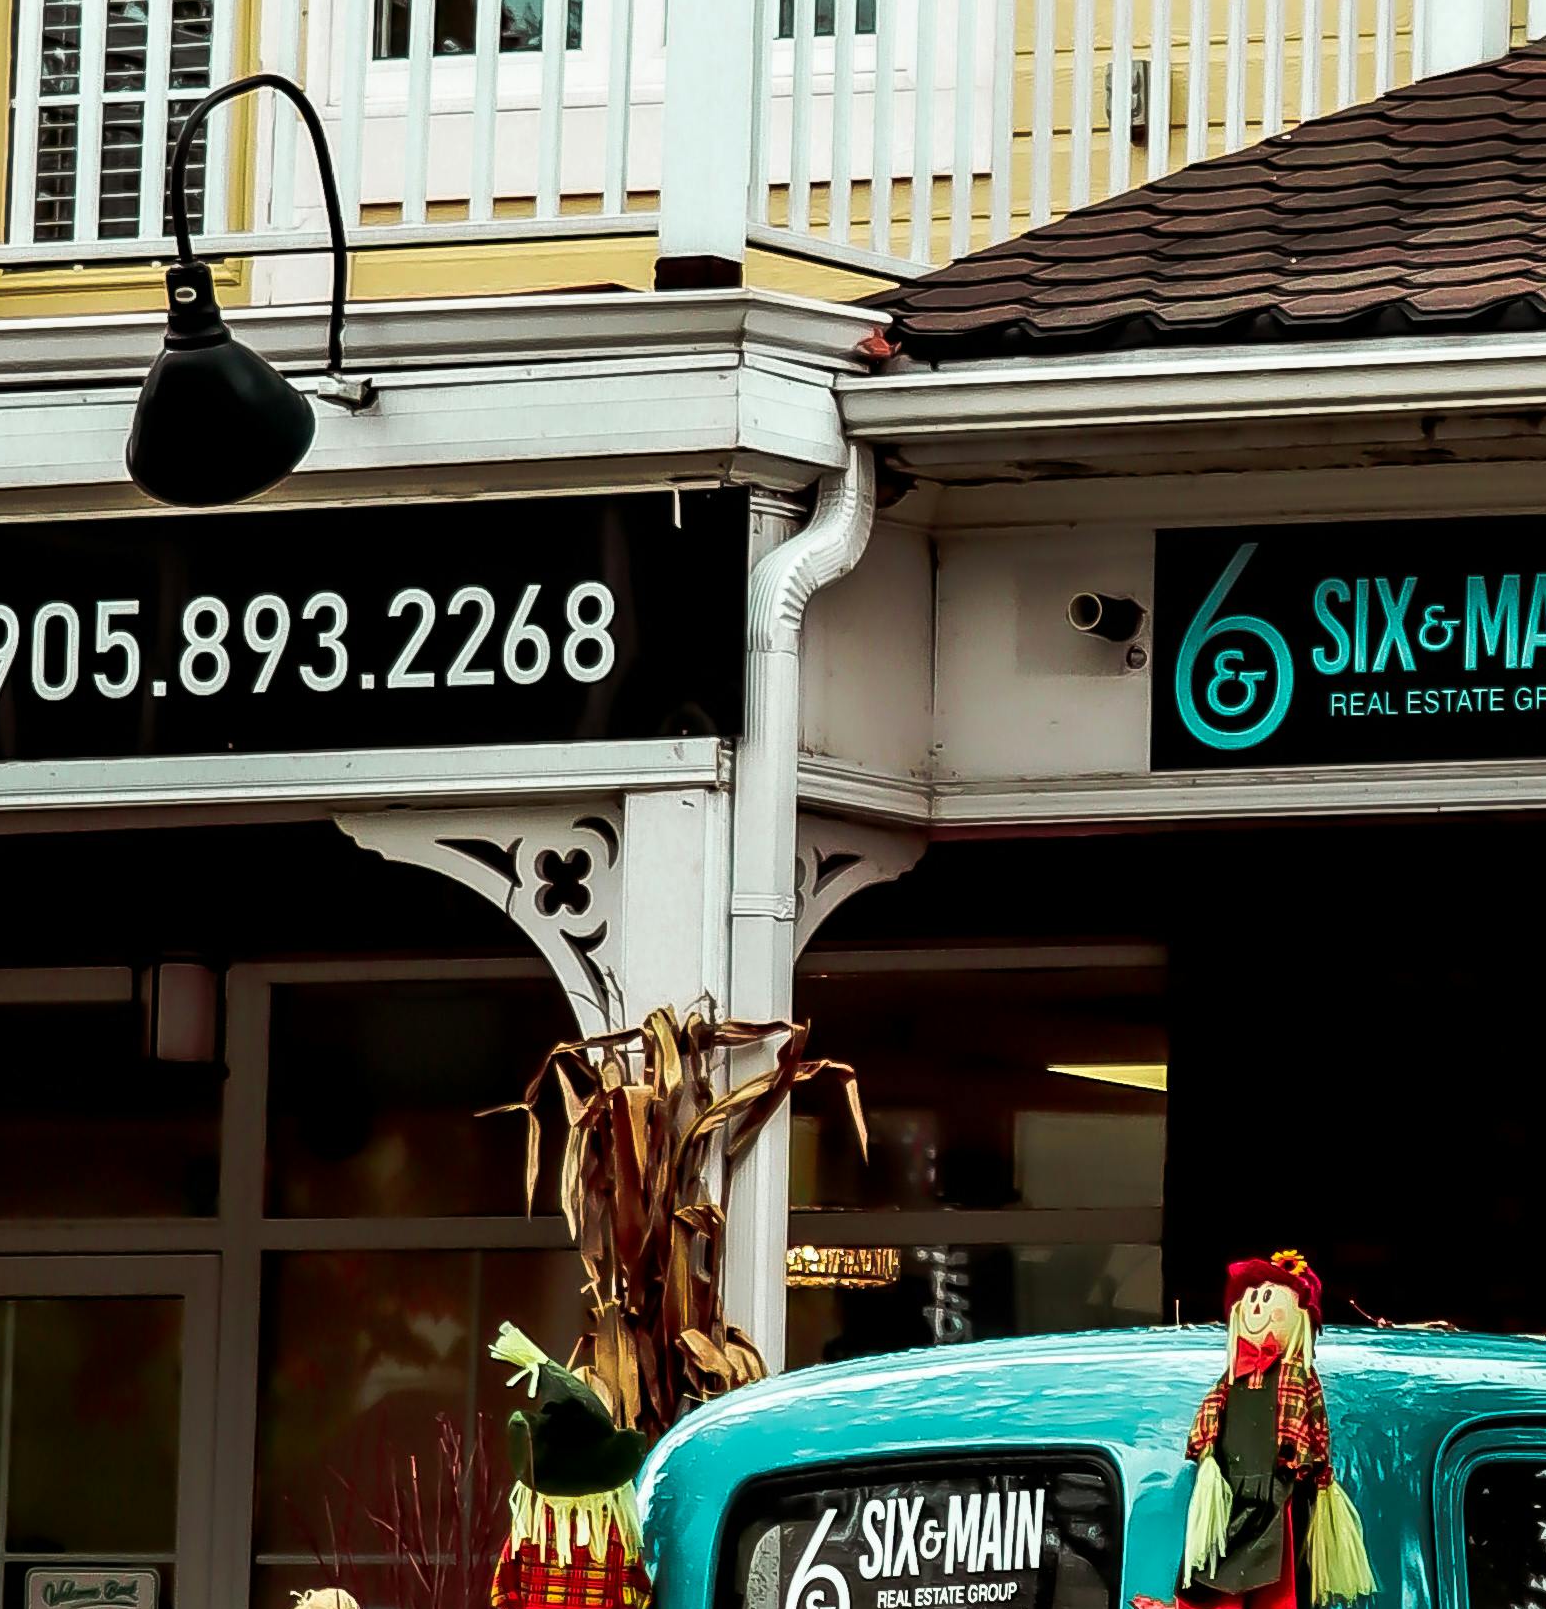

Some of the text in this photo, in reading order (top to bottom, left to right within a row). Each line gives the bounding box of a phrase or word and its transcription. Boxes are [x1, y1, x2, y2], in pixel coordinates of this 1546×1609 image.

[1330, 692, 1398, 717] REAL
[1406, 688, 1504, 715] ESTATE
[877, 1582, 1017, 1609] REAL ESTATE GROUP
